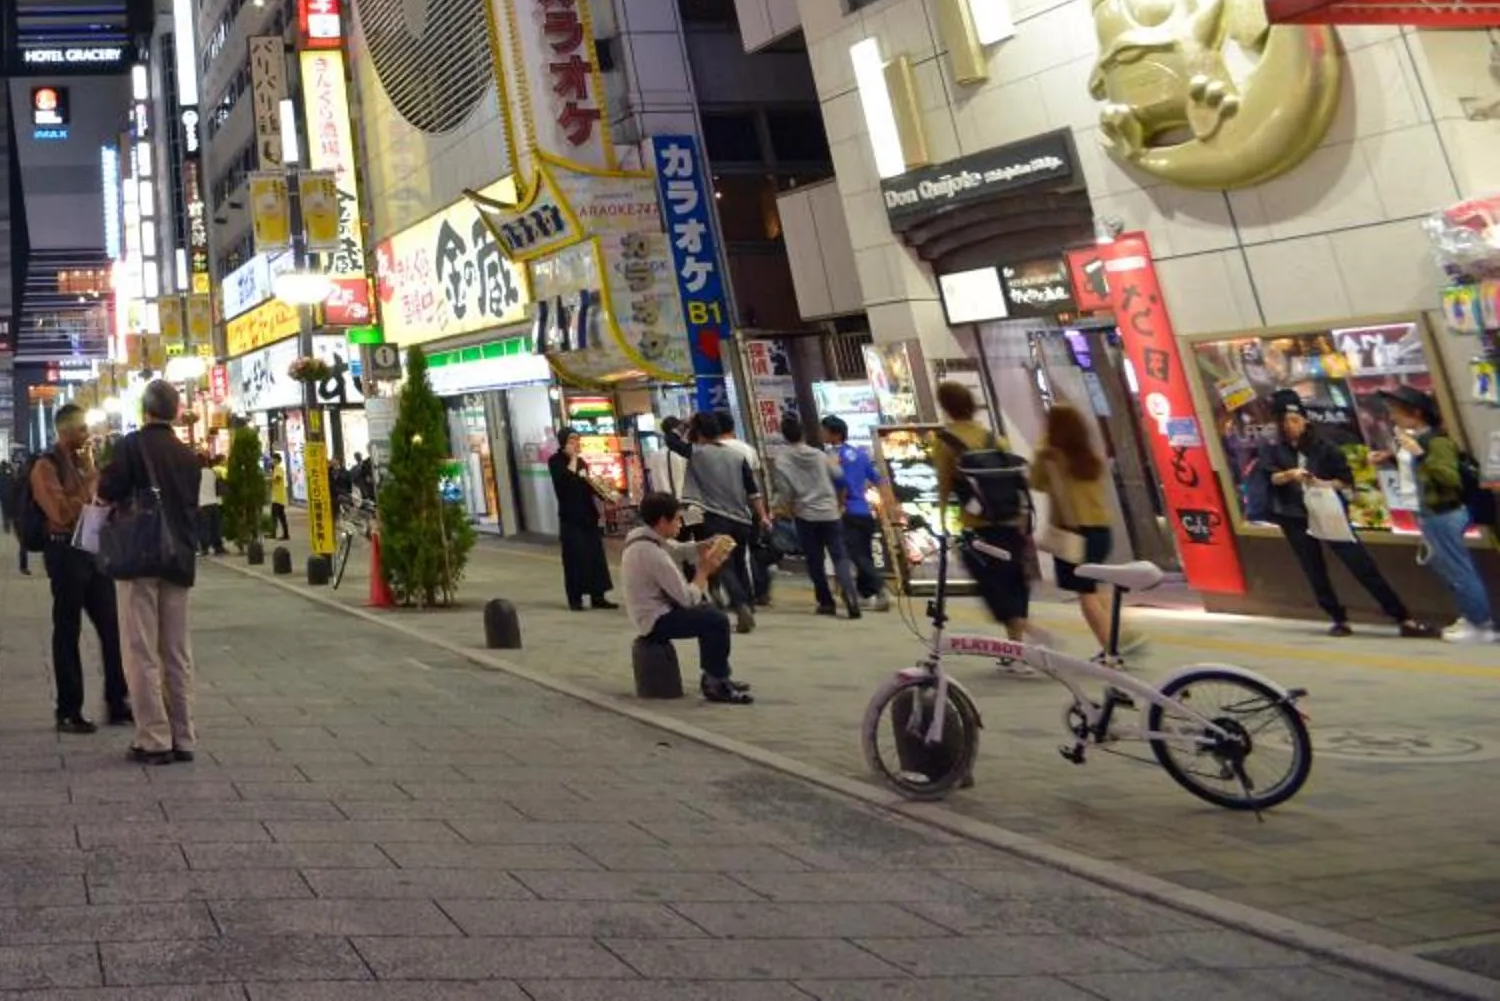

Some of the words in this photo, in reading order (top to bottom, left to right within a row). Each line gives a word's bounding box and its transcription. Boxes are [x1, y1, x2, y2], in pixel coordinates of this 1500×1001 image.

[25, 49, 65, 63] HOTEL
[65, 47, 122, 62] GRACERY
[659, 143, 715, 292] カラオケ
[687, 301, 722, 325] B1
[949, 637, 1024, 659] PLAYBOY
